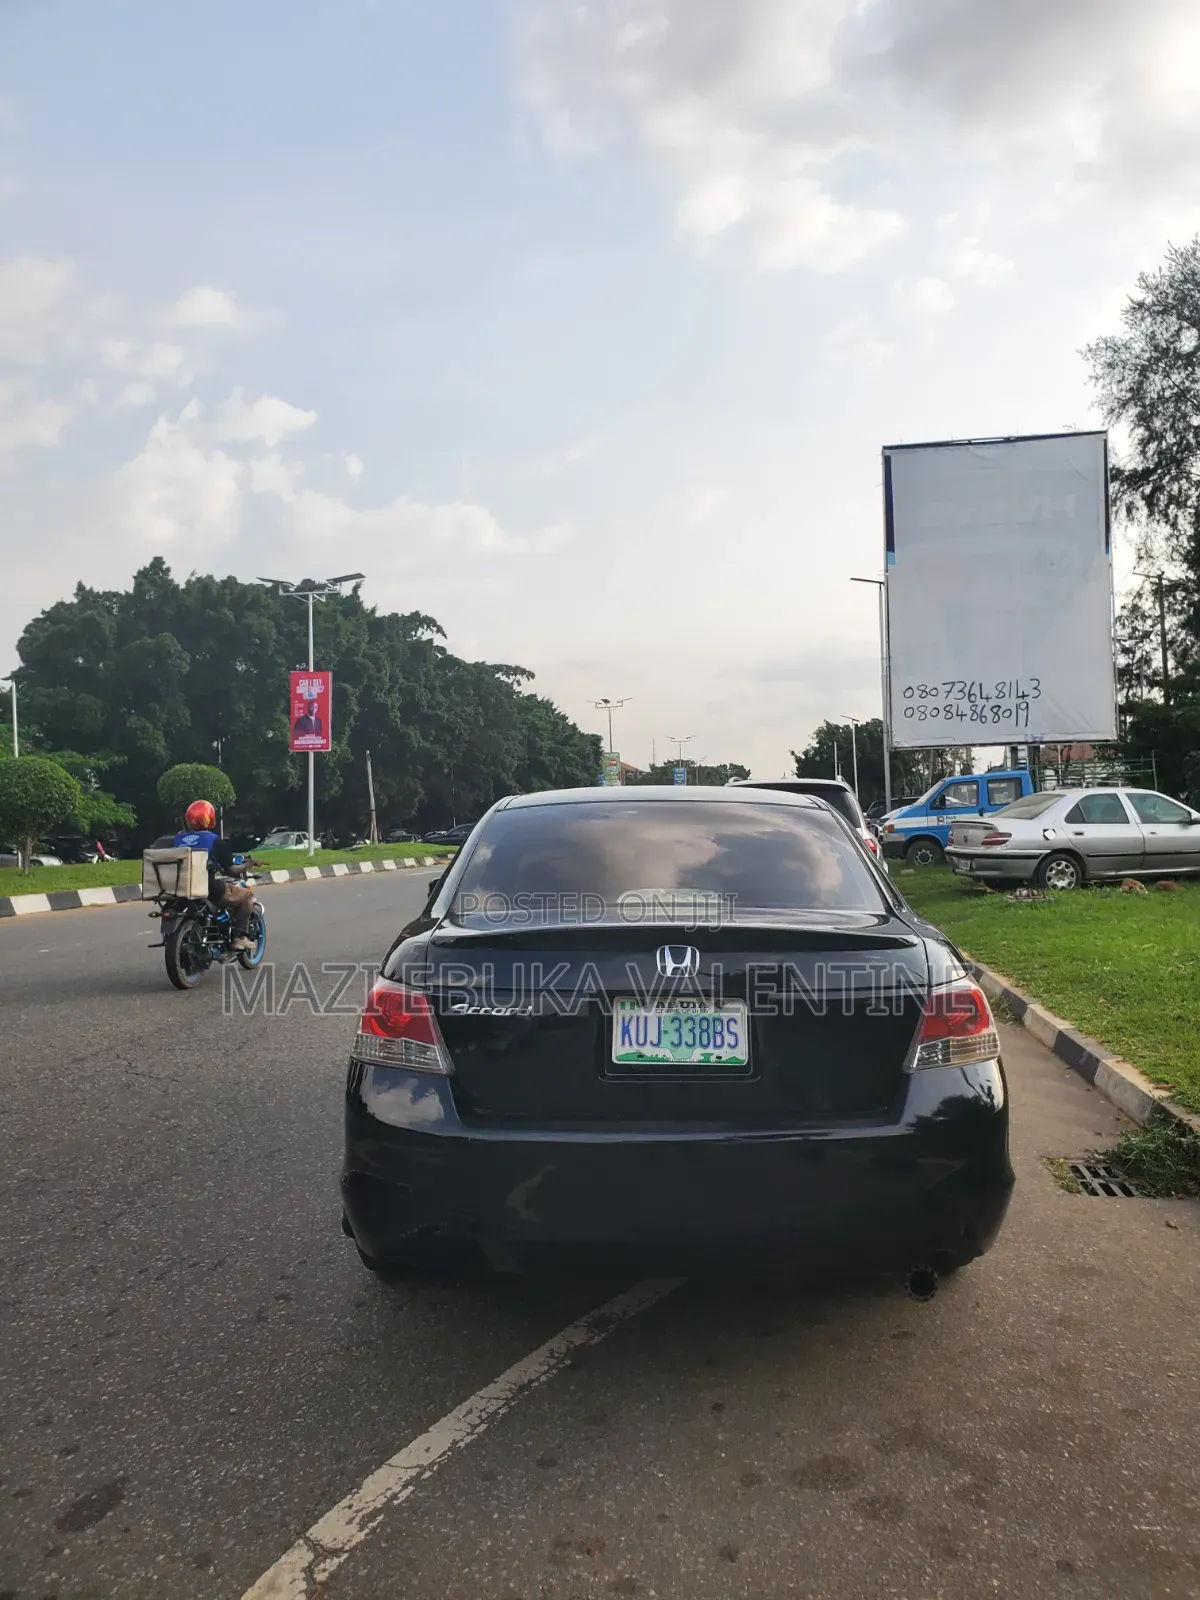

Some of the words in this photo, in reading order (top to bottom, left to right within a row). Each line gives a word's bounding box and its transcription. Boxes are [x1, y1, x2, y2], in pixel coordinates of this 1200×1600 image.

[903, 678, 1042, 703] 08073648143
[903, 701, 1029, 727] 08084868019
[442, 1003, 534, 1017] Accord
